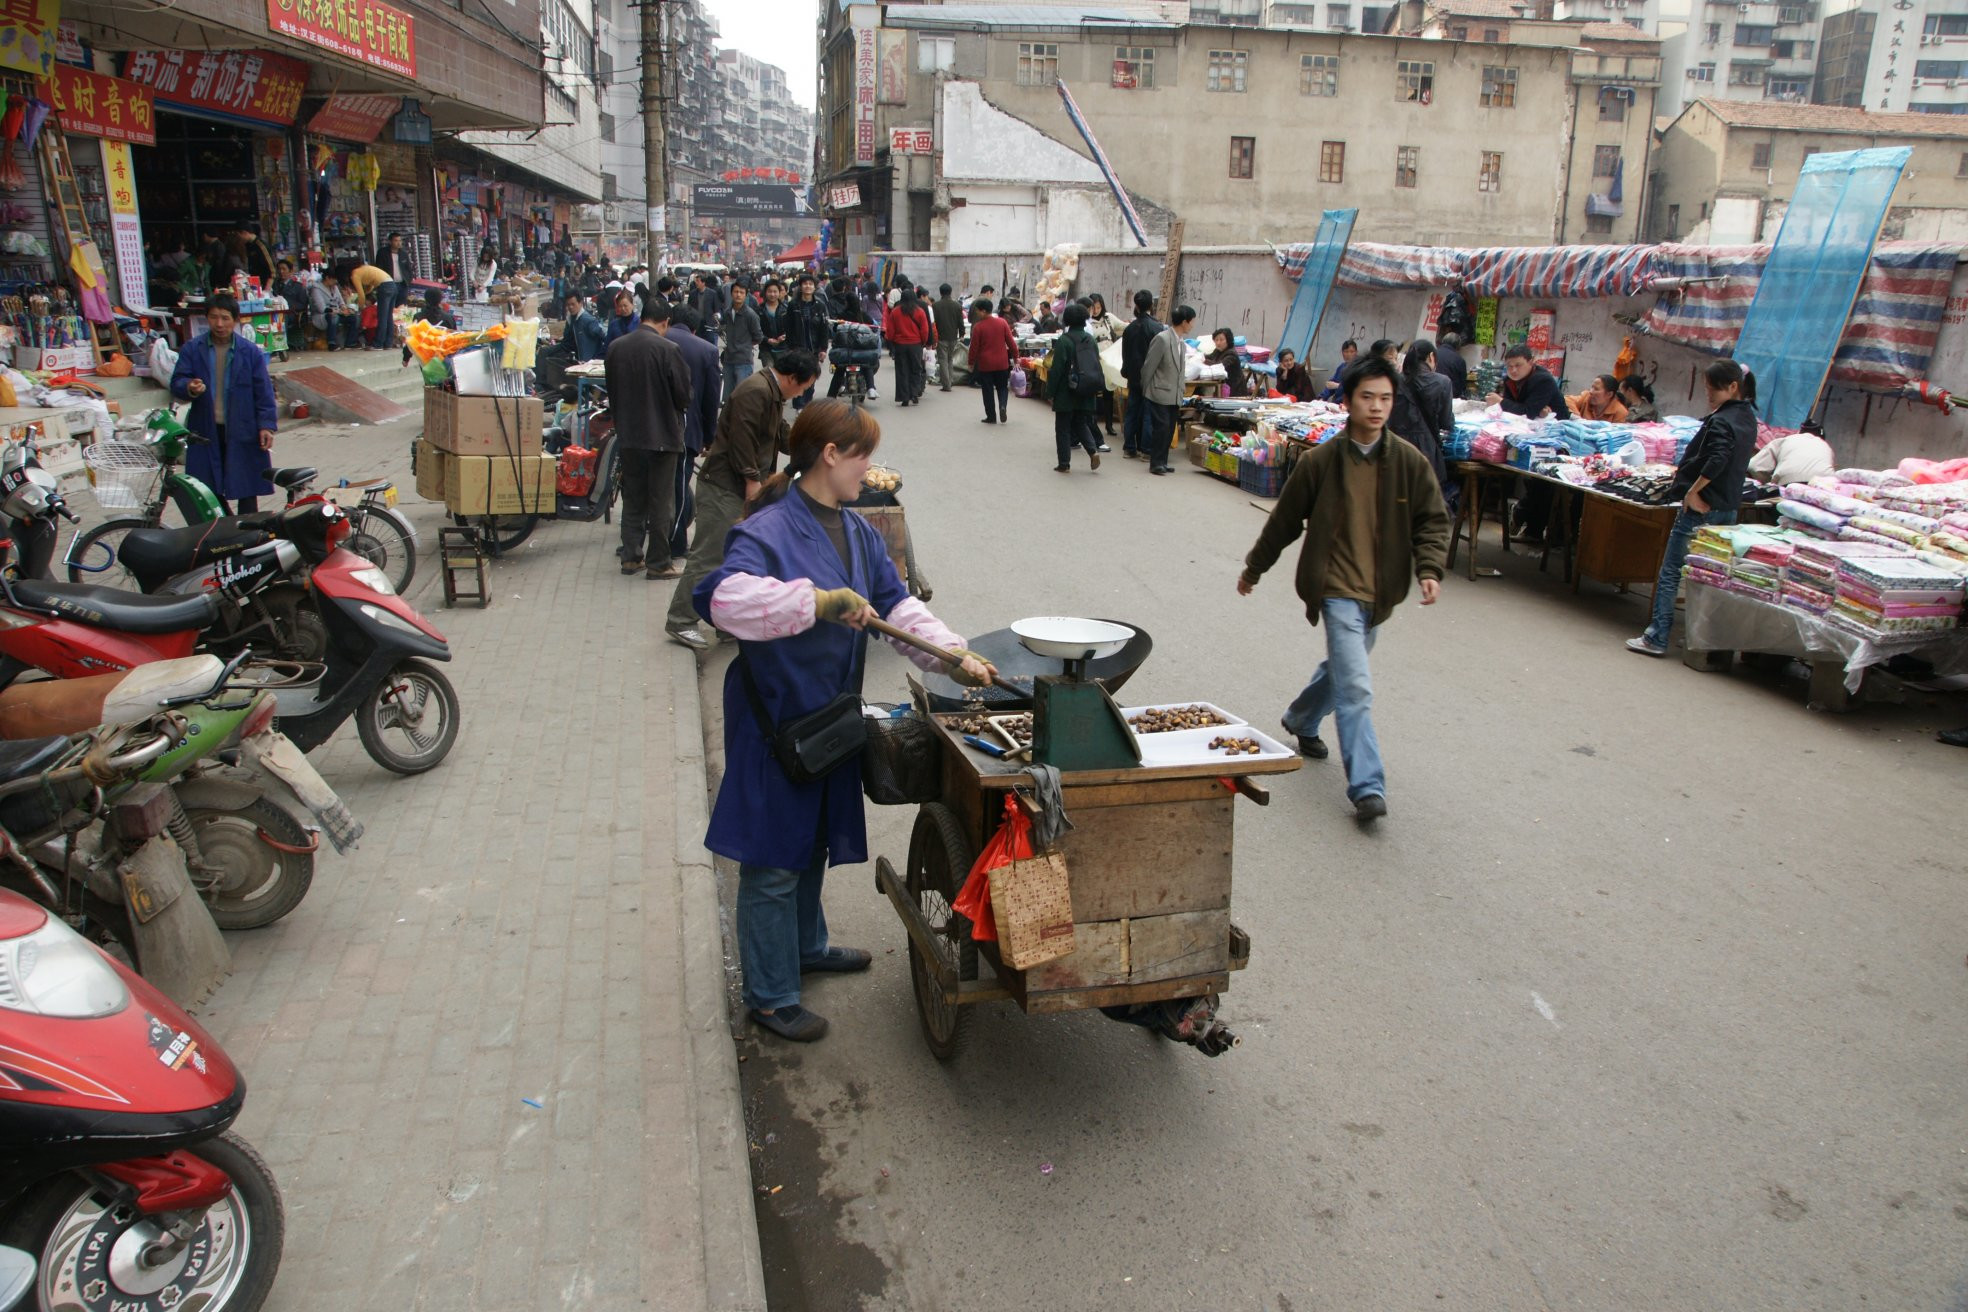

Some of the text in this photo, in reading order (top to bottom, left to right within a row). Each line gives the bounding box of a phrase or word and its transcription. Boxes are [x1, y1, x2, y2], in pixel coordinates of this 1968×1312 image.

[858, 28, 874, 161] 佳美家床上用品
[892, 130, 933, 153] 年画
[833, 186, 860, 205] 挂历
[82, 1231, 109, 1272] YLPA
[184, 1239, 207, 1278] YLPA
